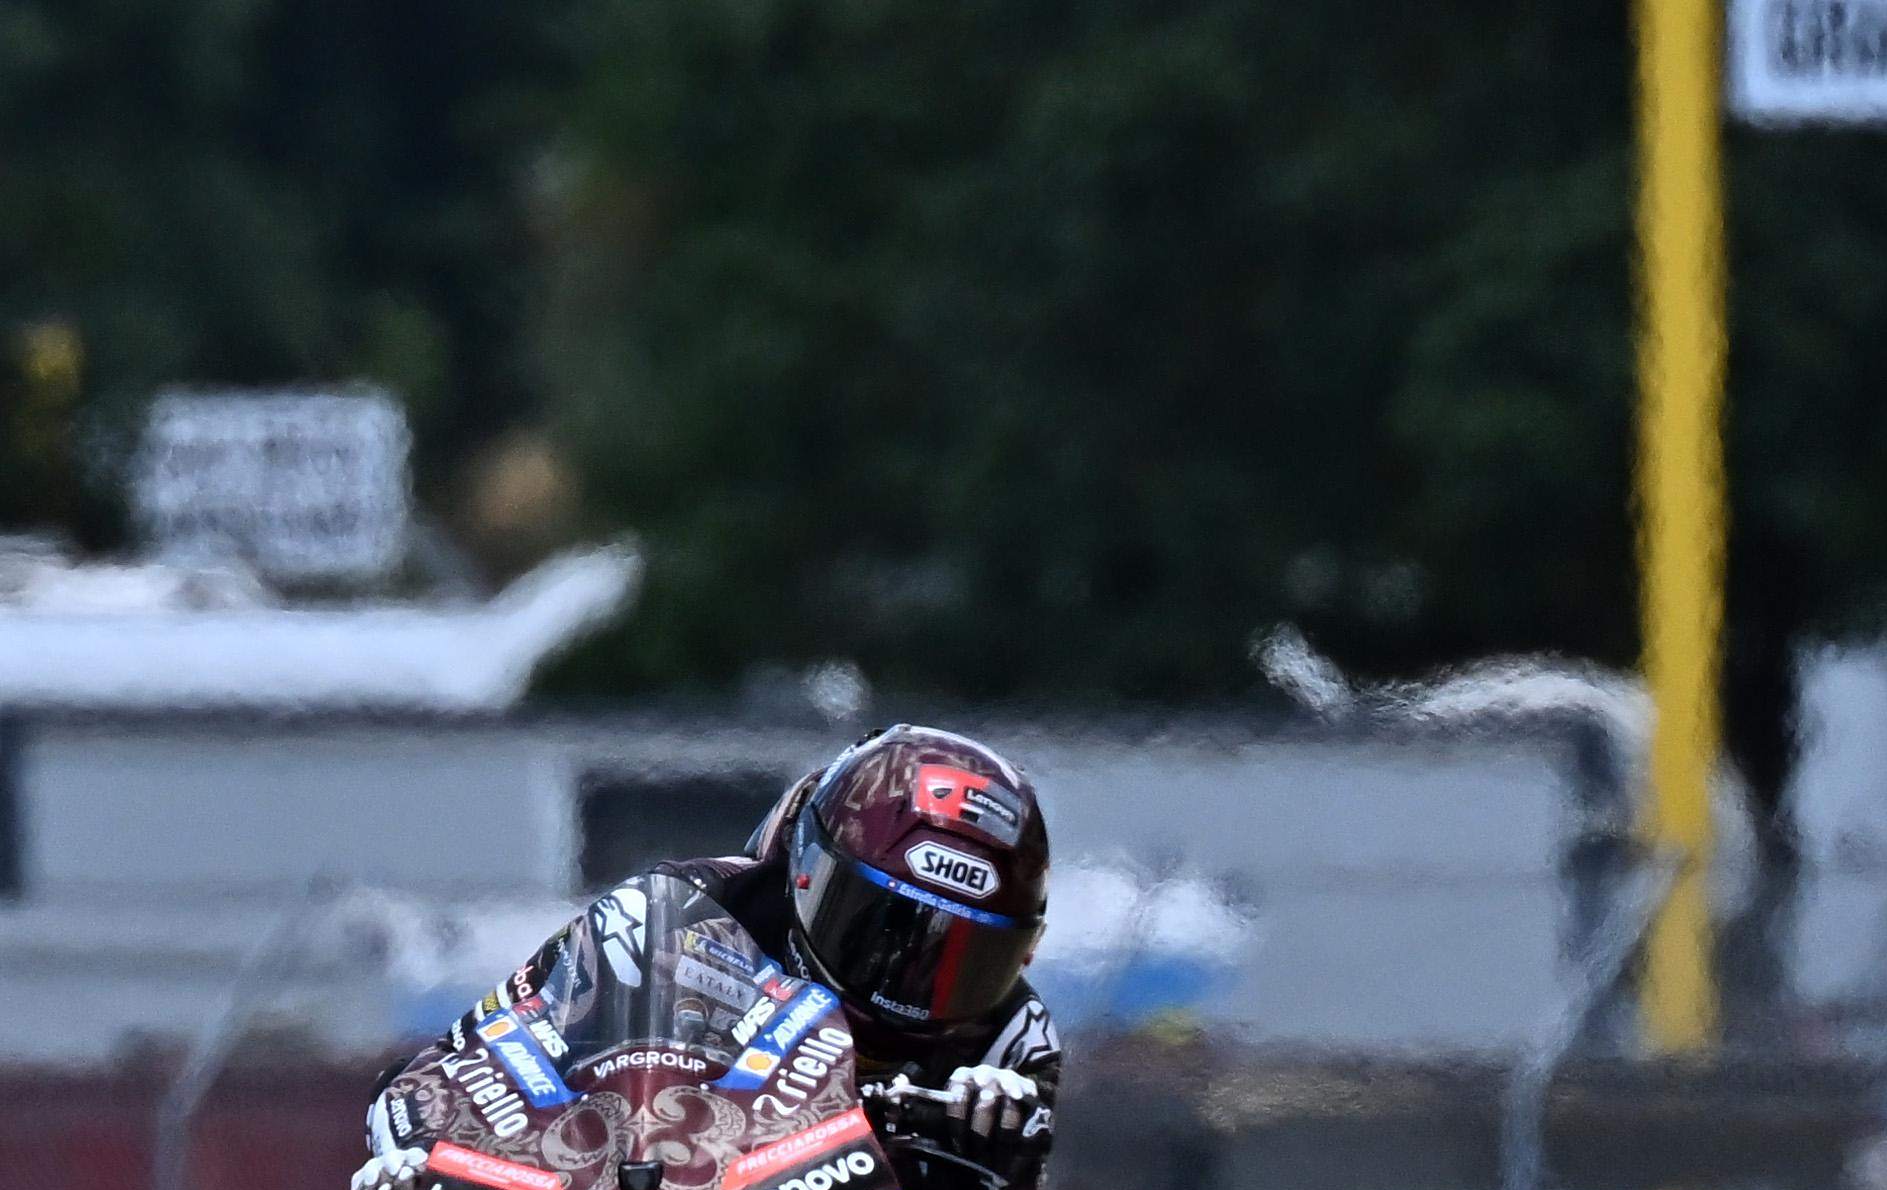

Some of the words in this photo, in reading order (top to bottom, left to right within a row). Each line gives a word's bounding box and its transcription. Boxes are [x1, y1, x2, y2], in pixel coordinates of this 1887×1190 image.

[921, 851, 988, 892] SHOEI
[870, 991, 930, 1020] Insta360
[592, 1051, 707, 1079] VARGROUP
